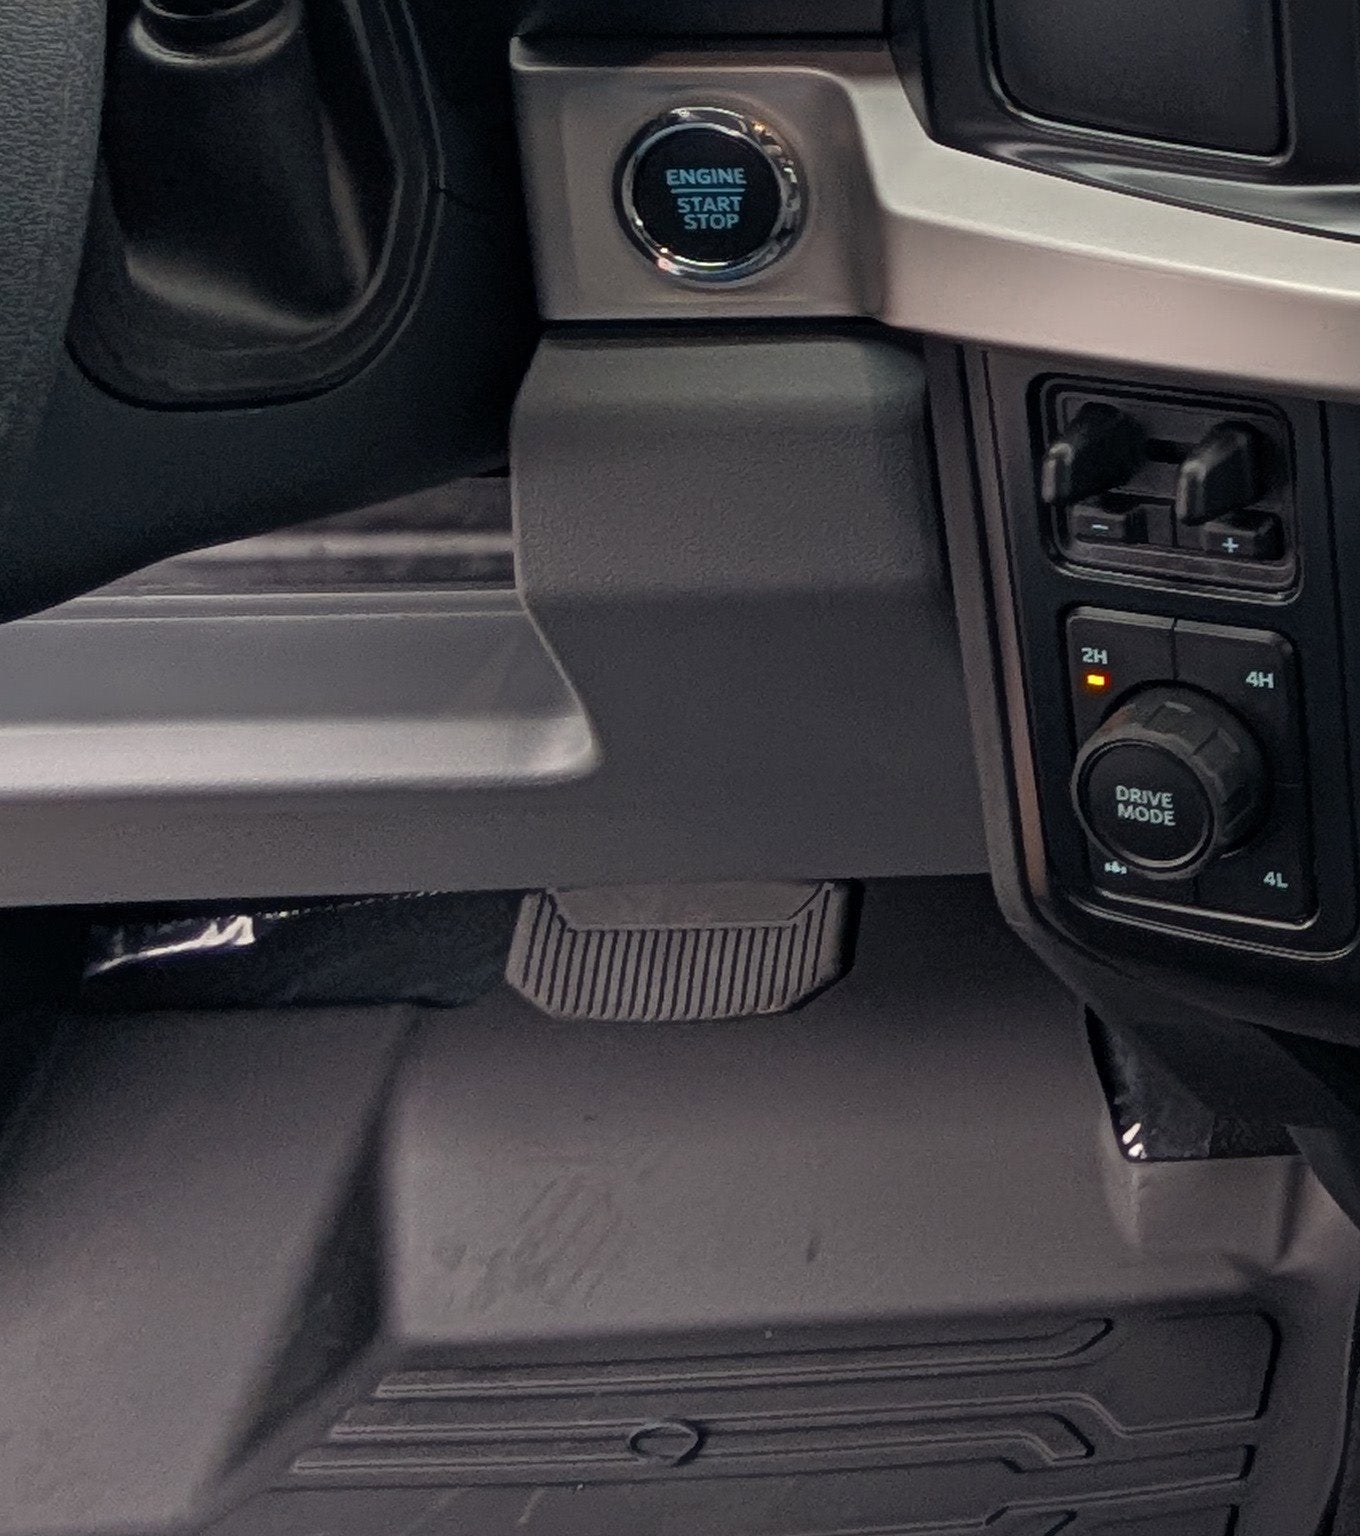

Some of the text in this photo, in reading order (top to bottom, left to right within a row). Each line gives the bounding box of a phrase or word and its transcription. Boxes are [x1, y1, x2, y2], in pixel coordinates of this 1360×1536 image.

[665, 168, 748, 186] ENGINE
[677, 196, 744, 213] START
[684, 214, 740, 230] STOP
[1081, 647, 1108, 664] 2H
[1246, 671, 1274, 689] 4H
[1115, 785, 1173, 808] DRIVE
[1117, 803, 1176, 826] MODE
[1263, 871, 1288, 889] 4L
